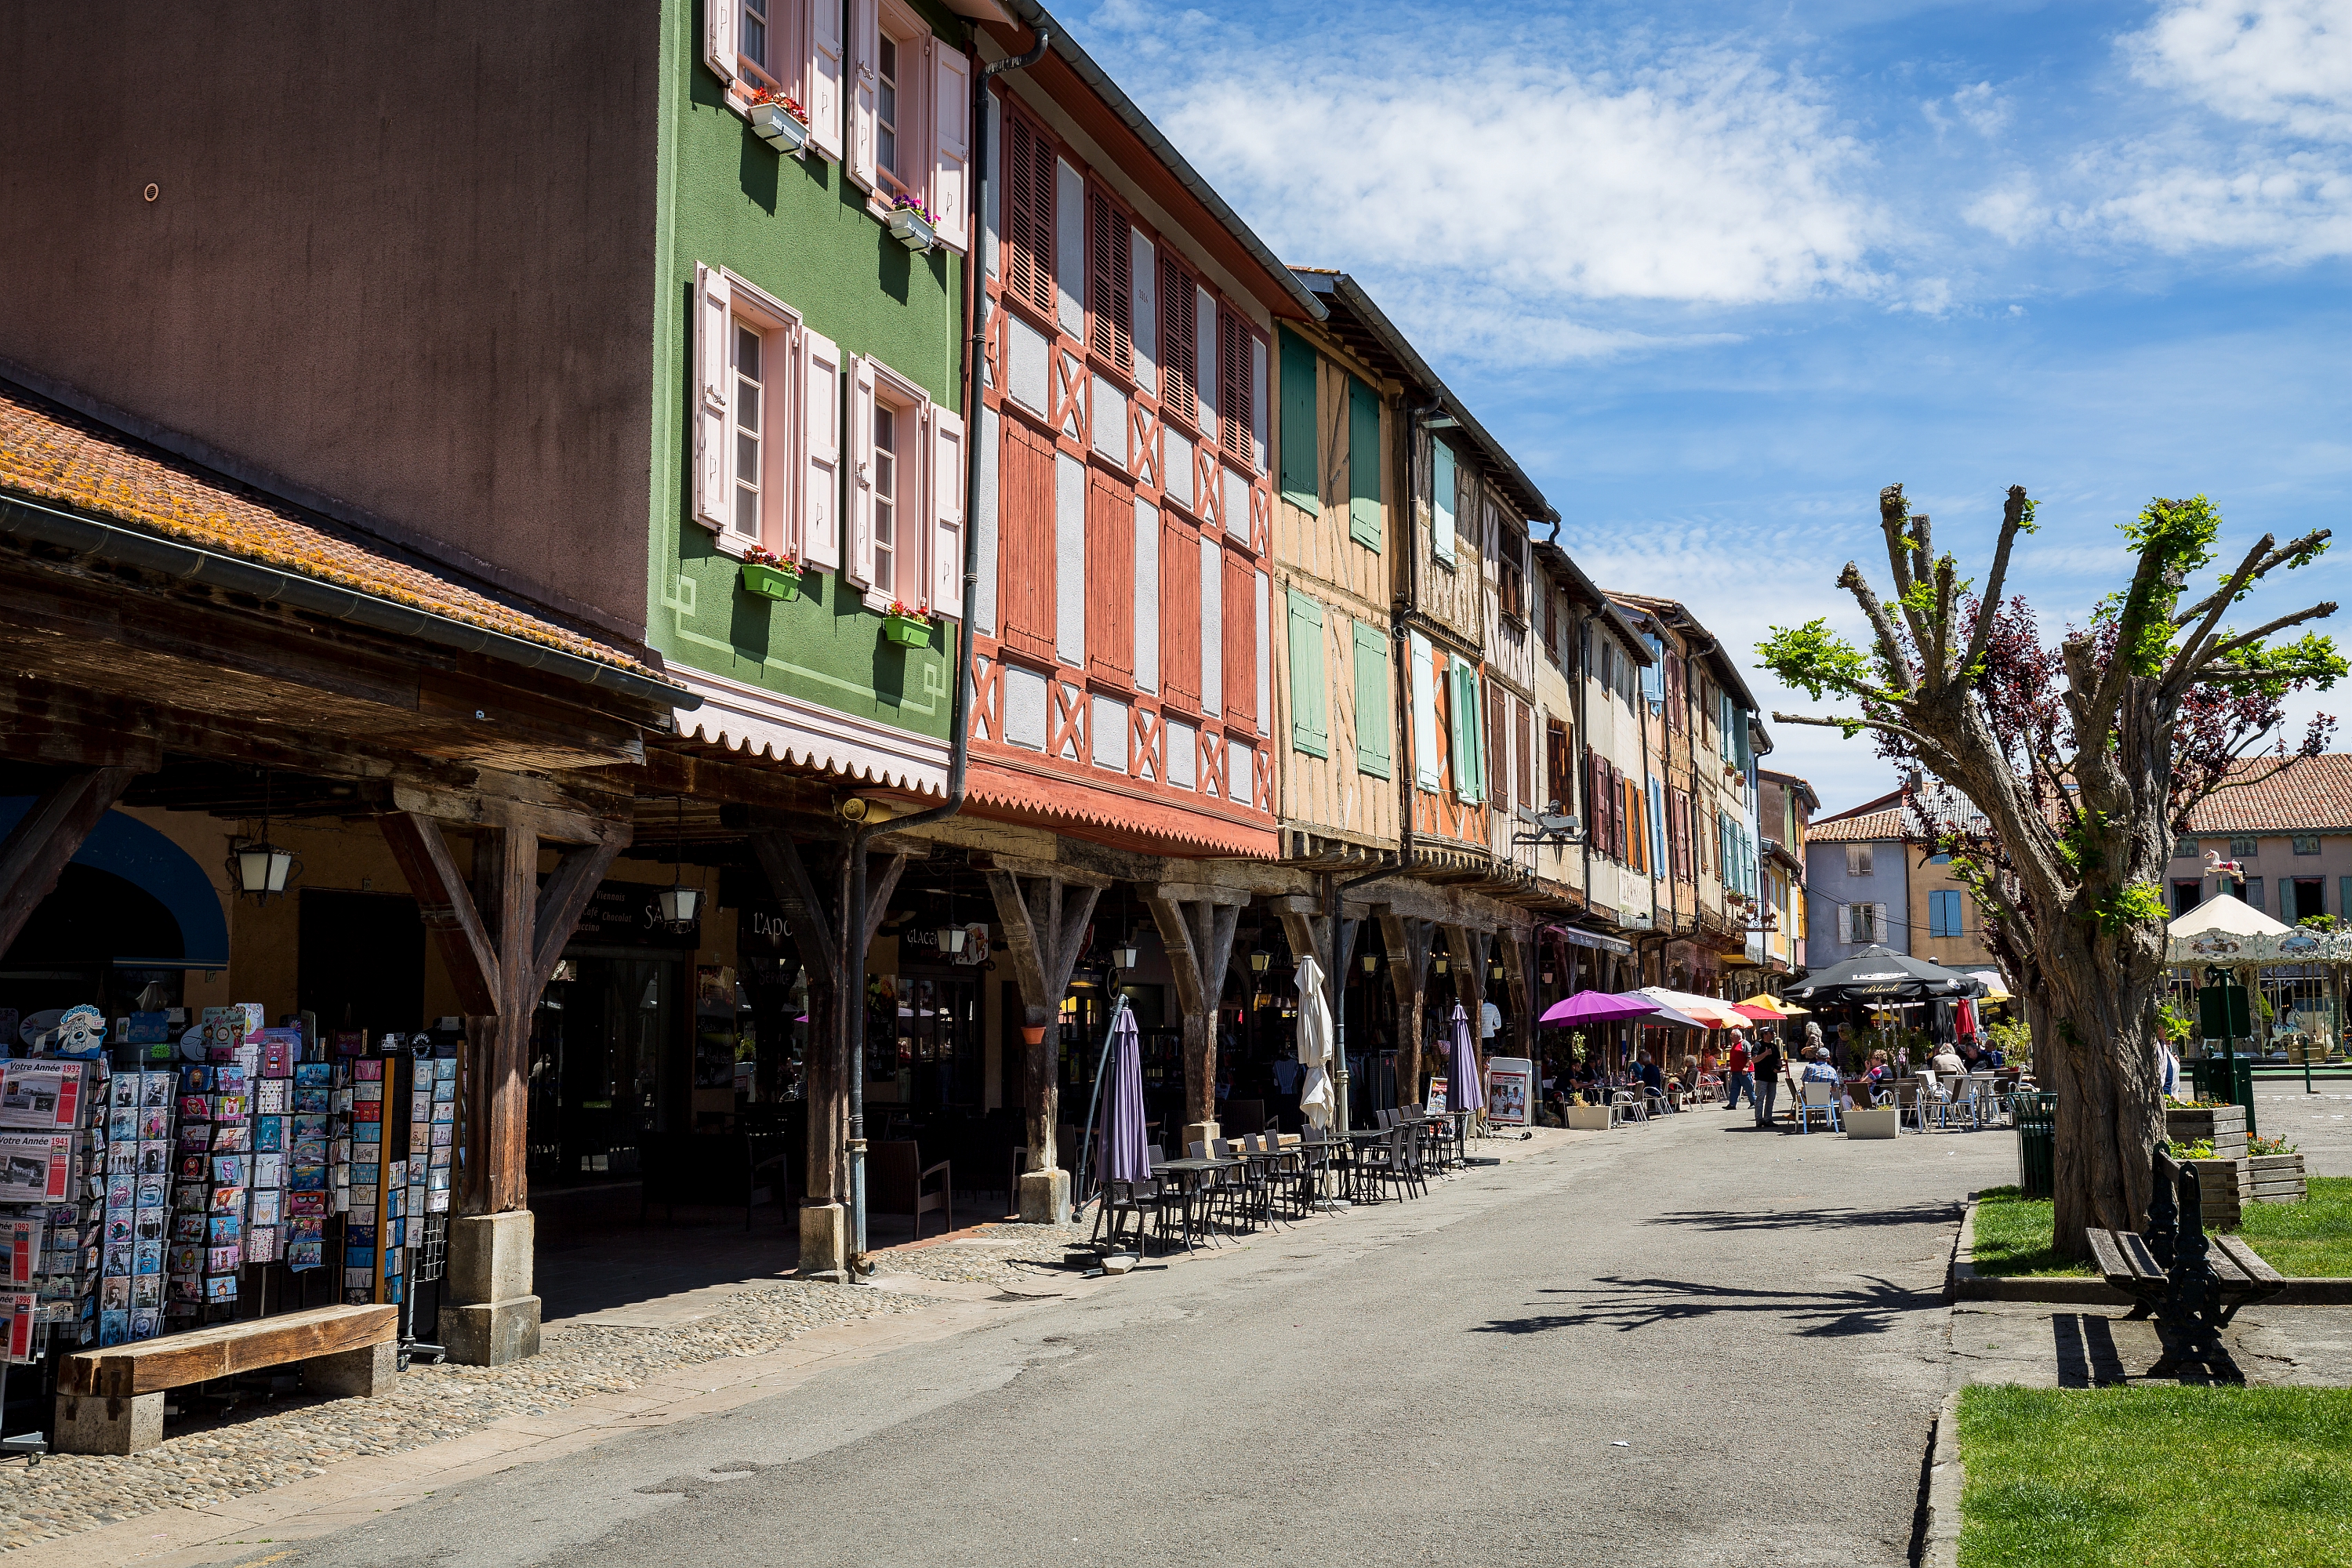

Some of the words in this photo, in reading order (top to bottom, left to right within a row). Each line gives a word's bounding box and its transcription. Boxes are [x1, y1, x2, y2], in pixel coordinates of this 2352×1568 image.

[596, 891, 626, 902] Viennois
[583, 907, 598, 918] Café
[602, 911, 632, 922] Chocolat
[644, 906, 664, 929] SA
[209, 972, 216, 981] 17
[1862, 981, 1902, 994] Black
[10, 1062, 32, 1071] Votre
